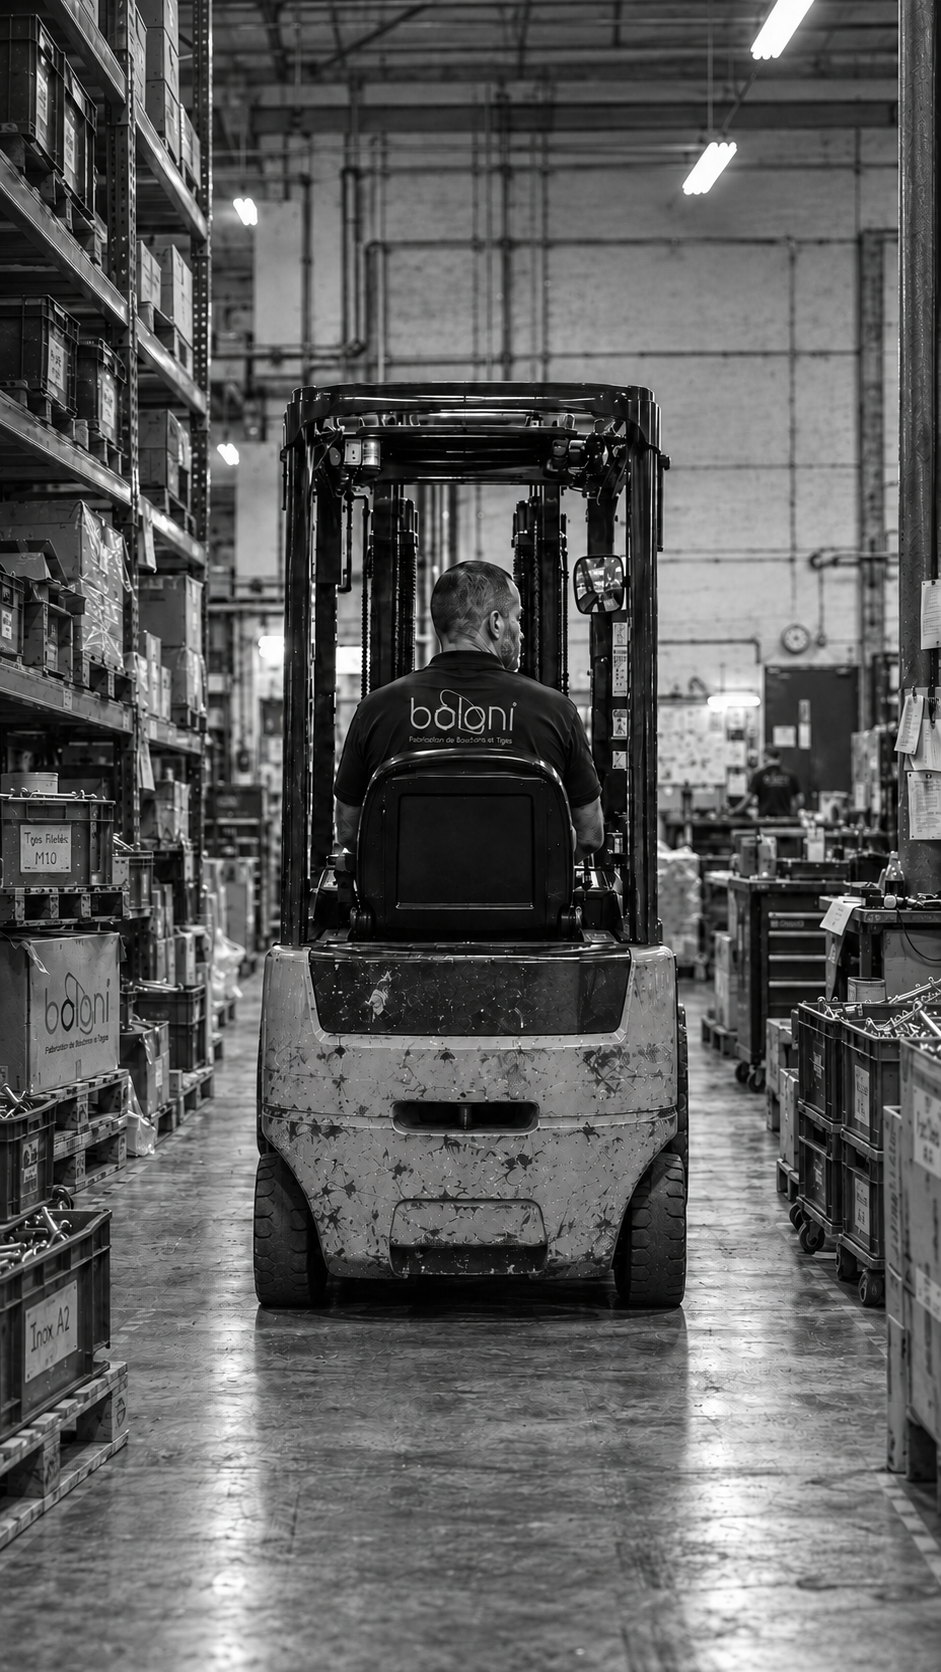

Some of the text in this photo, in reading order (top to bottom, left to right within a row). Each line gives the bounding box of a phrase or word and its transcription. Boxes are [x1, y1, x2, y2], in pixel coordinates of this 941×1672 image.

[35, 851, 57, 865] M10
[30, 1305, 70, 1353] Inox A2
